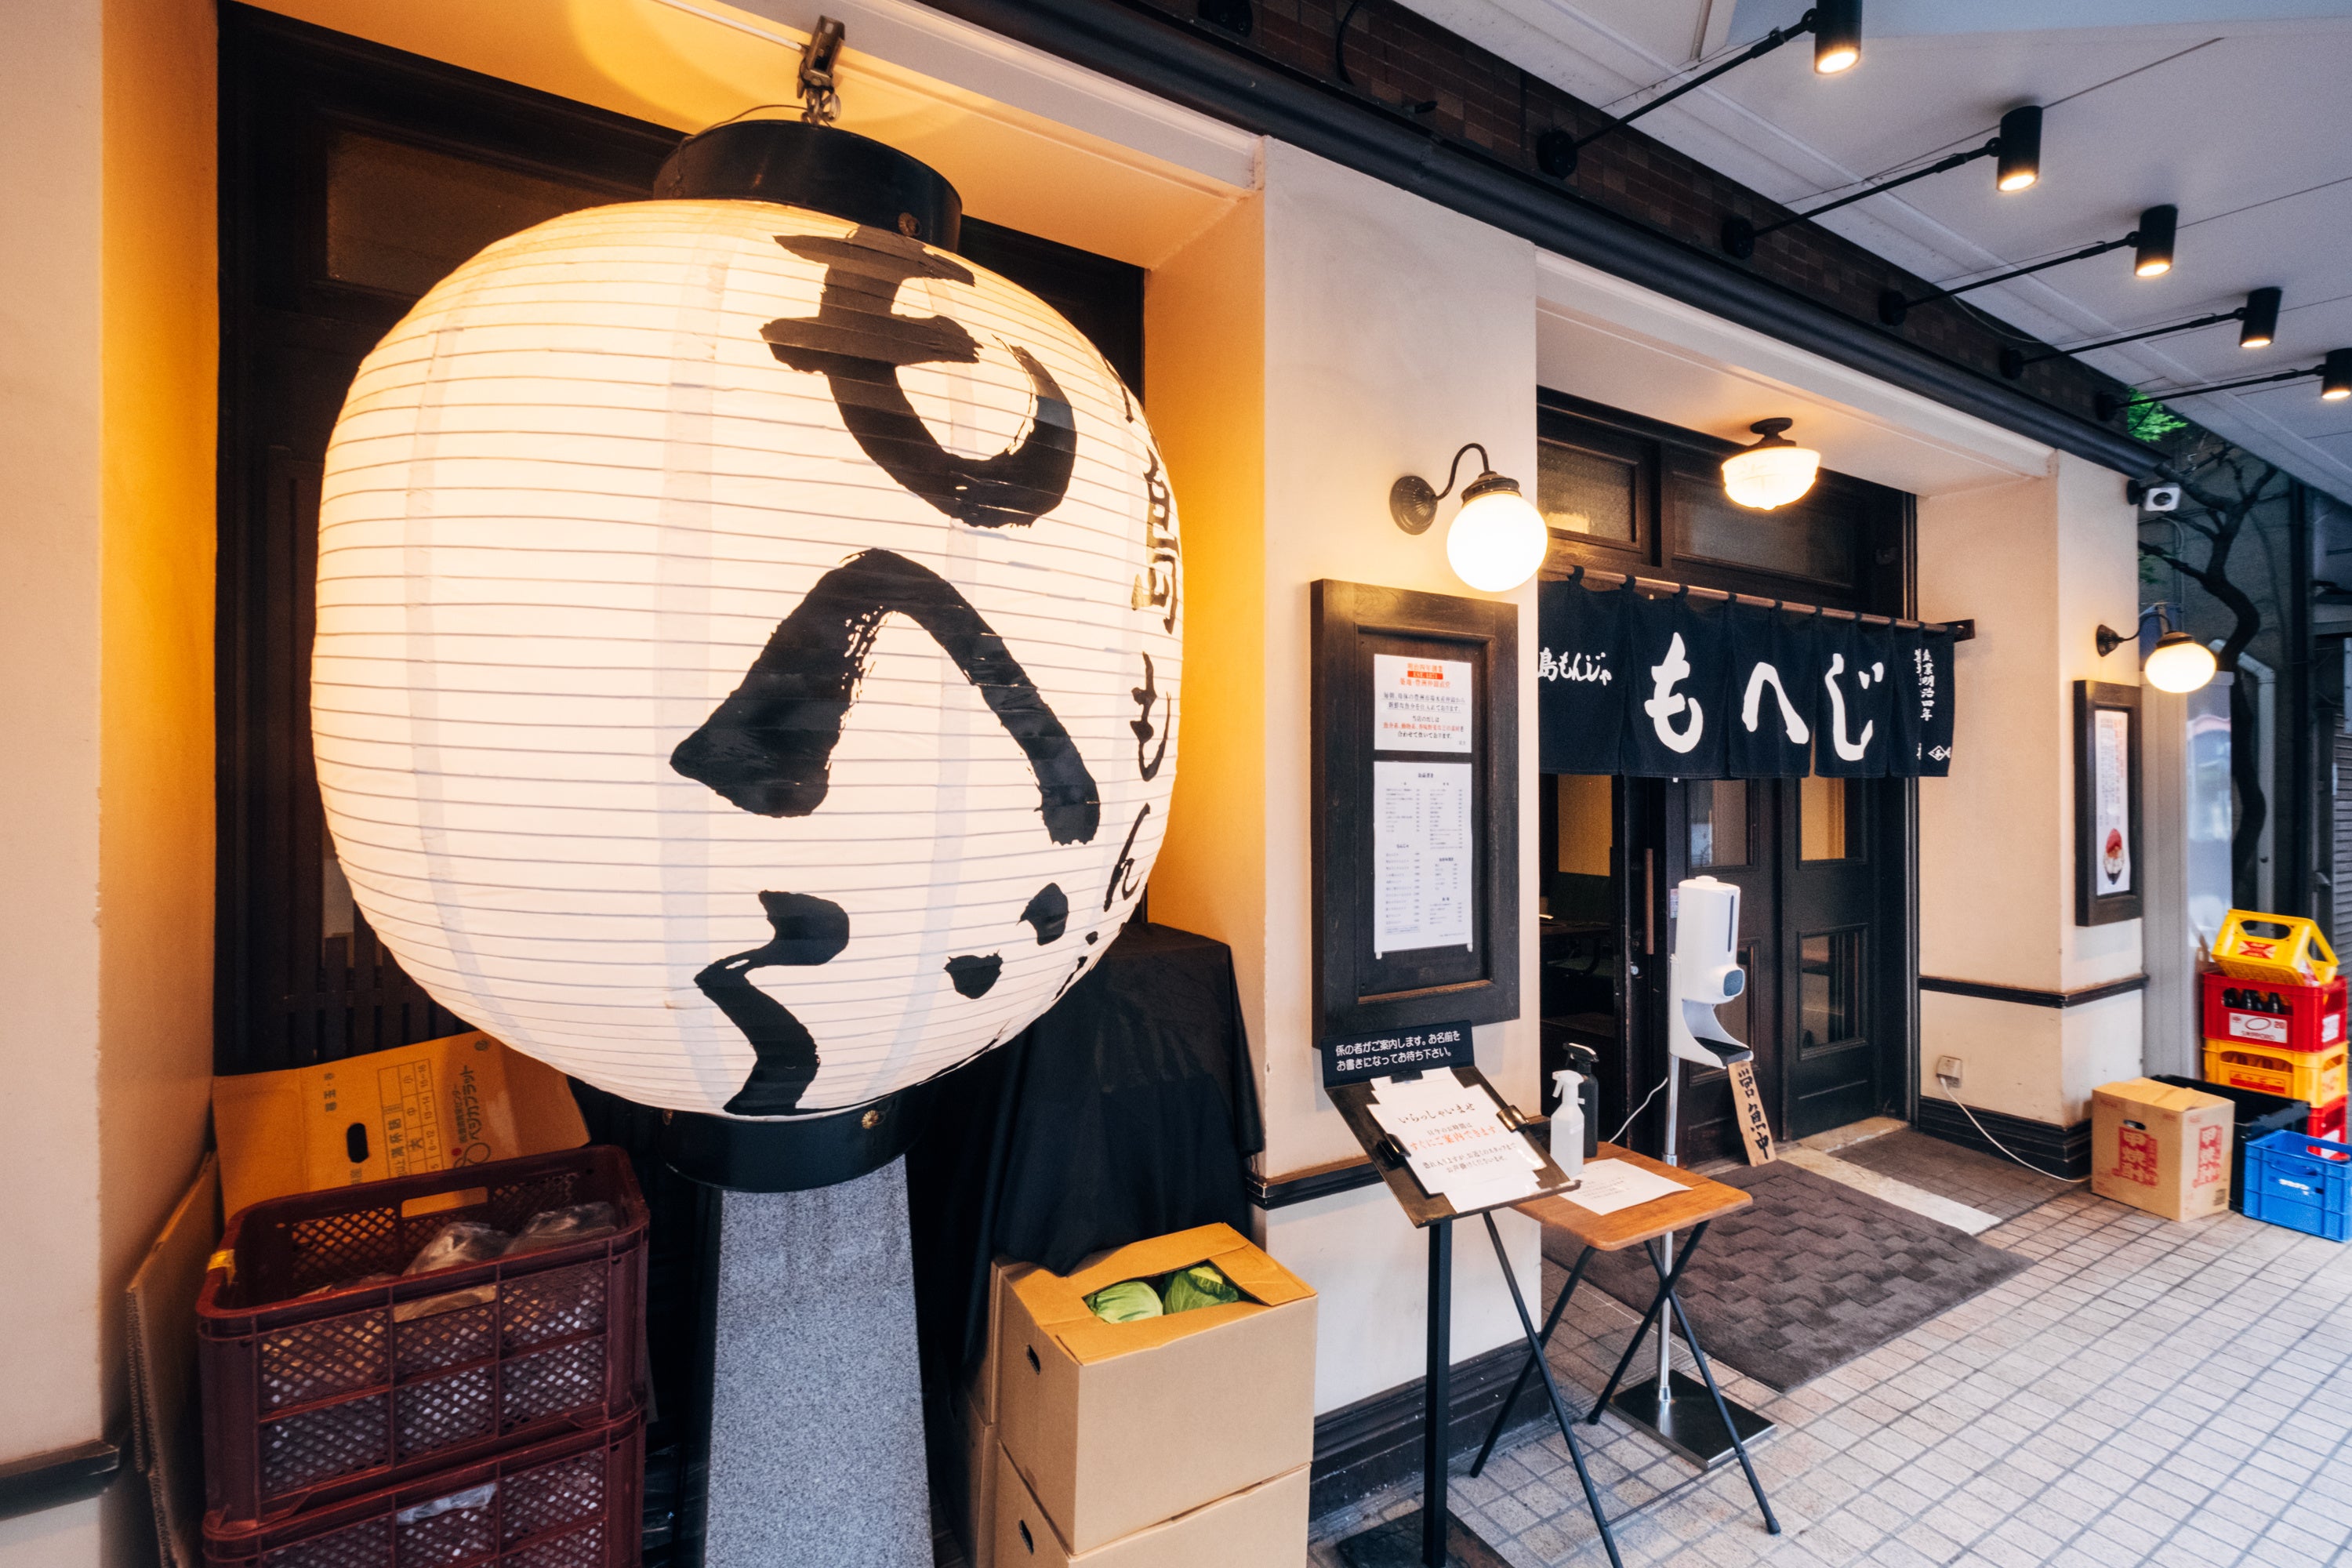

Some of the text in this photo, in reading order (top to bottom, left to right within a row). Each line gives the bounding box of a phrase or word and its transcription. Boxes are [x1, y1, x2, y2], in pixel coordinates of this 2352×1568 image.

[670, 223, 1101, 1116] もへじ
[1644, 632, 1884, 761] もへじ
[1337, 1047, 1452, 1072] お書きになってお待ち下さい。
